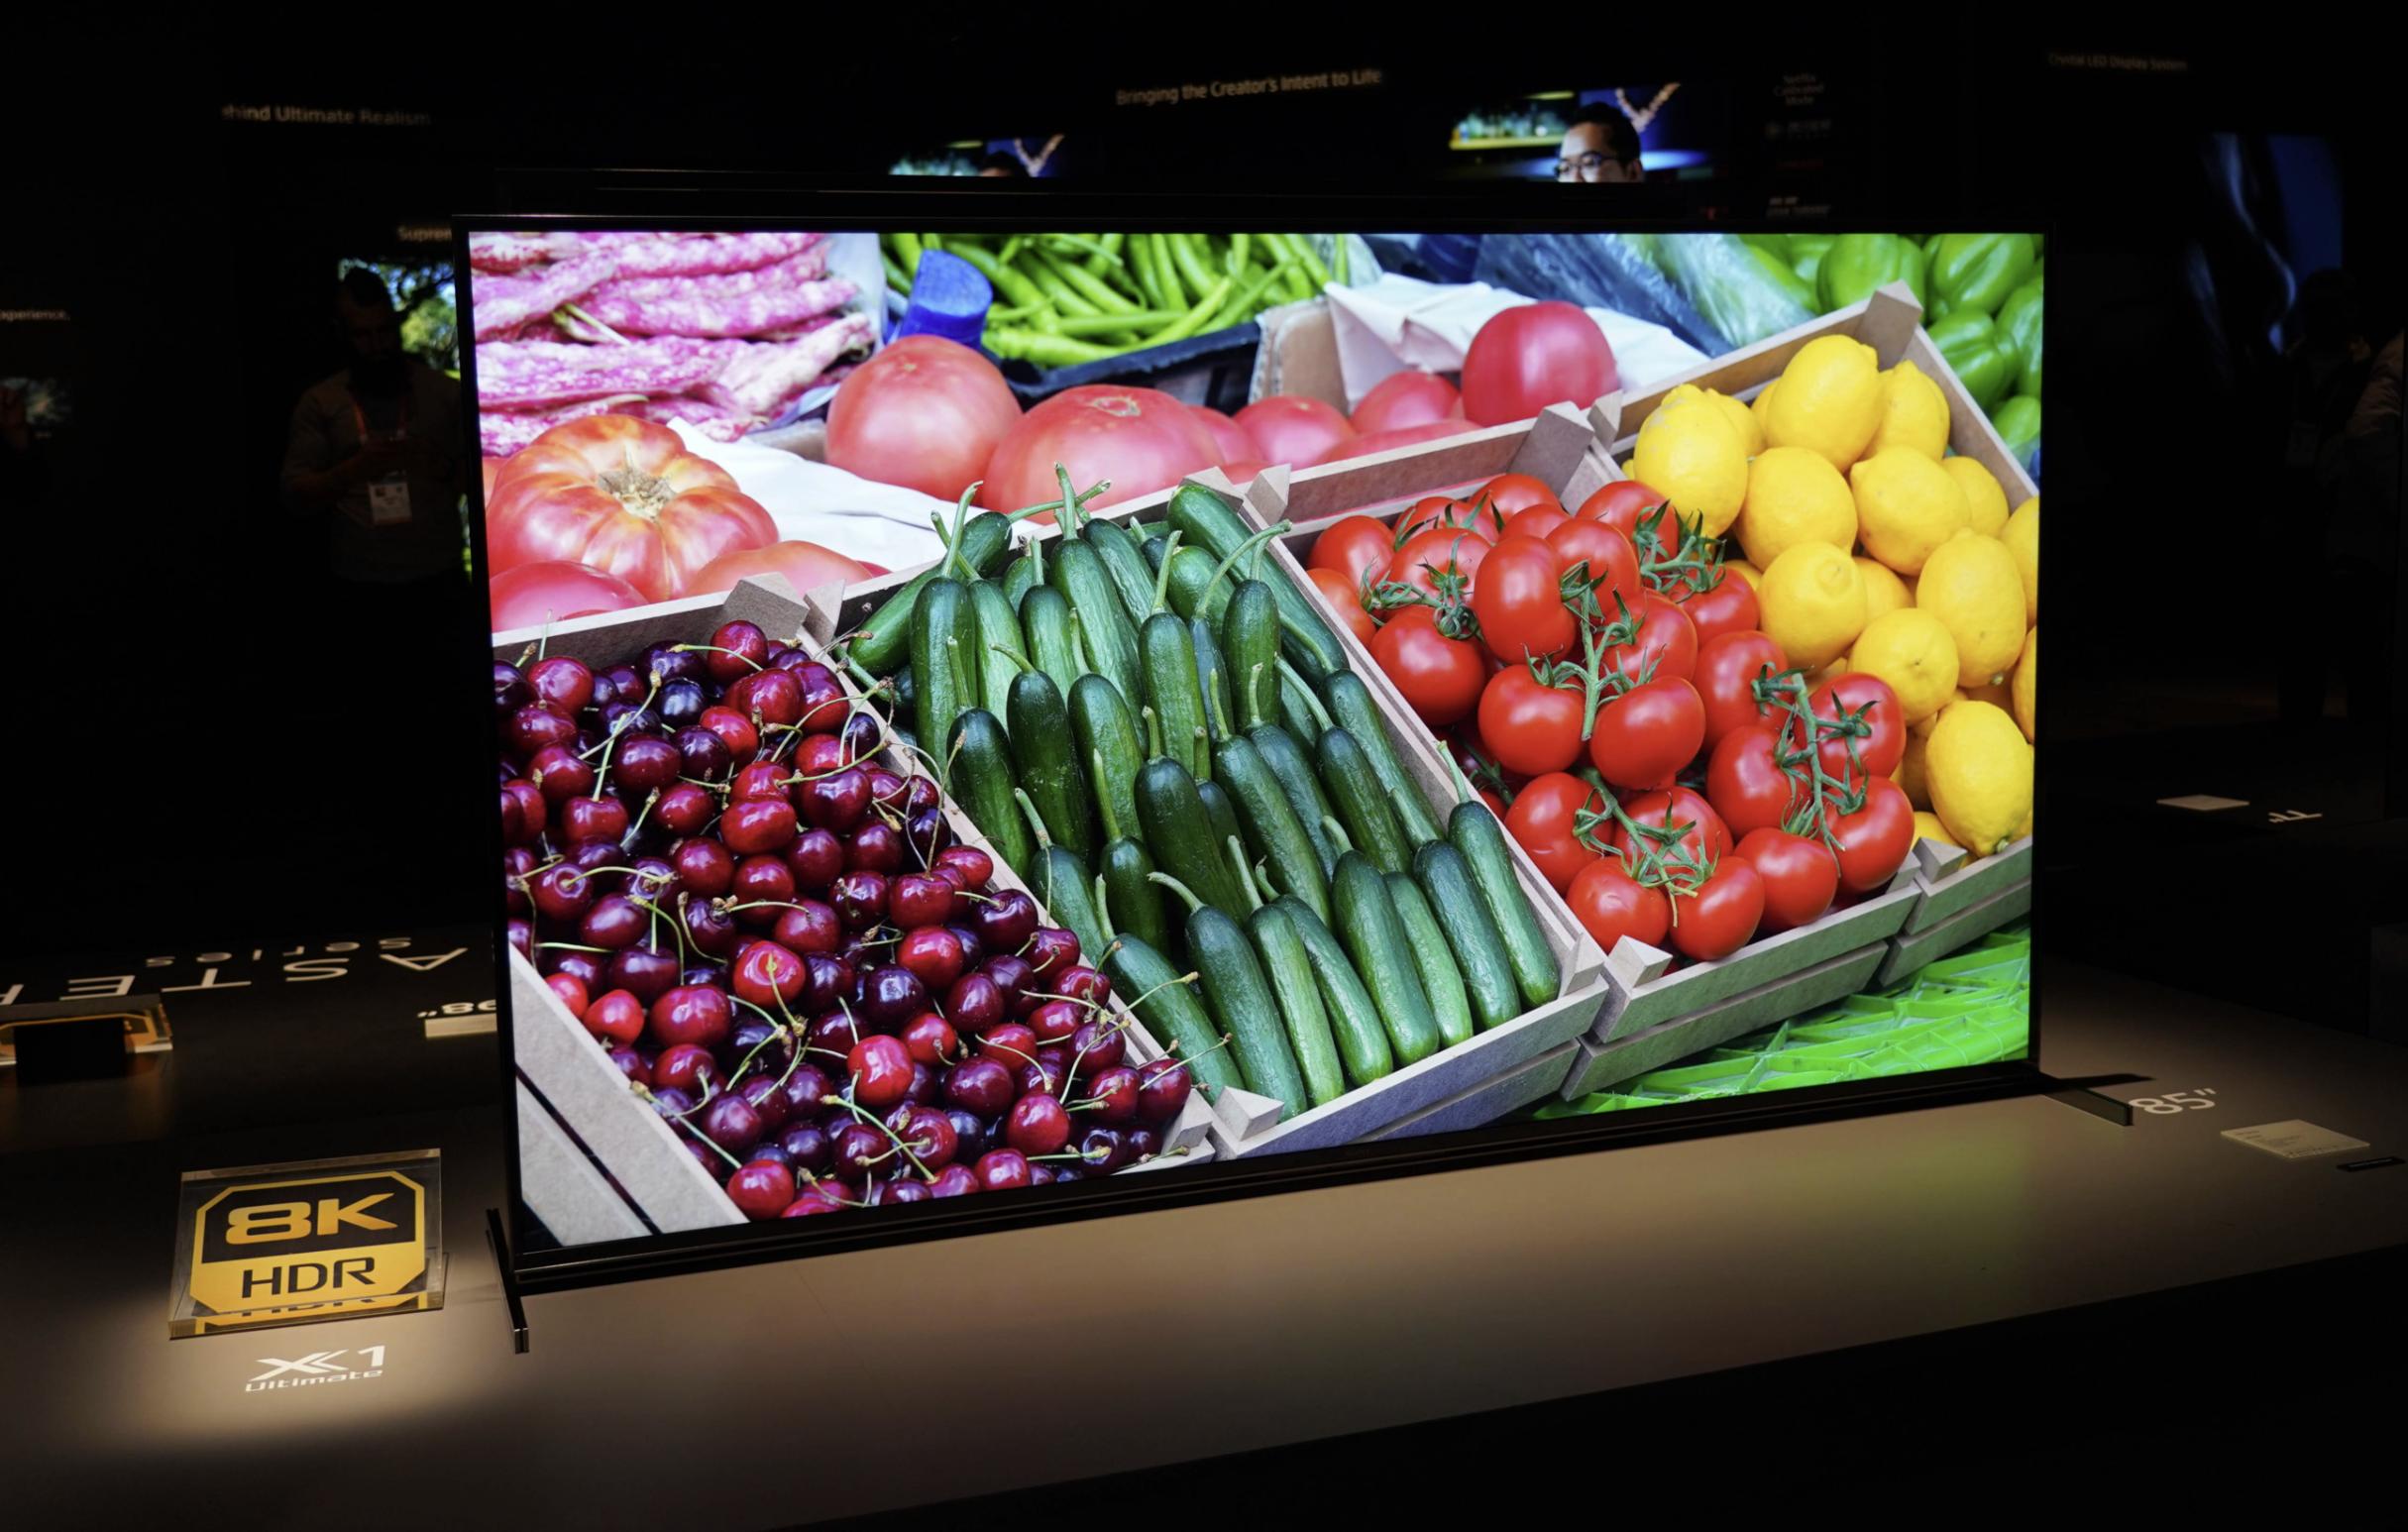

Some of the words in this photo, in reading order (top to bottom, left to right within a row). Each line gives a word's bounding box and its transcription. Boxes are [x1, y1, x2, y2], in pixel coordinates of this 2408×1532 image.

[1115, 86, 1179, 107] Bringing
[1181, 83, 1207, 100] the
[1210, 77, 1278, 98] Creator's
[1280, 72, 1328, 91] Intent
[1331, 69, 1350, 87] to
[1352, 65, 1382, 85] Life
[274, 103, 355, 125] Ultimate
[358, 106, 433, 127] Realism
[2128, 1088, 2217, 1114] 85"
[225, 1192, 398, 1246] 8K
[241, 1256, 377, 1299] HDR
[245, 1368, 383, 1392] Ultimate
